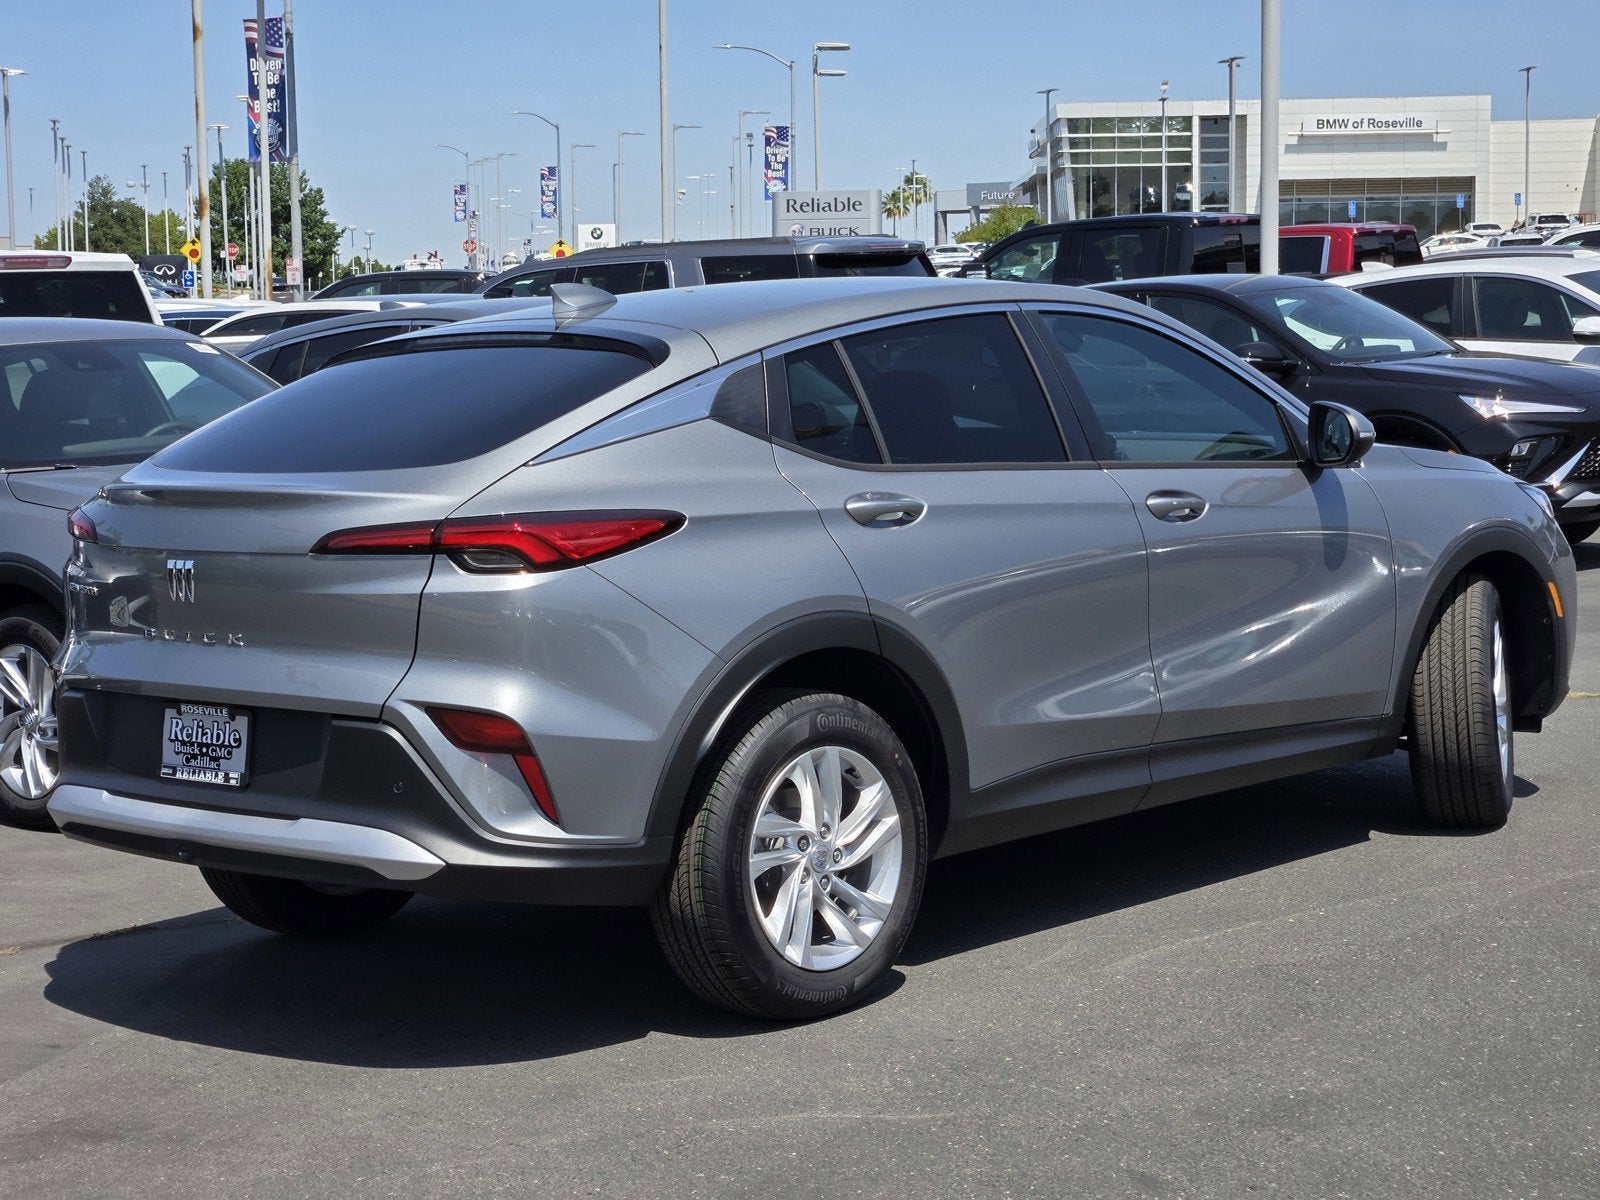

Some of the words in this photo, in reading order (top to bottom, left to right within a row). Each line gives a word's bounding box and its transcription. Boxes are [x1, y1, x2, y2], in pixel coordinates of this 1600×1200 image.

[267, 71, 280, 85] Be
[254, 100, 280, 113] Bst!
[1316, 118, 1349, 129] BMW
[1352, 117, 1364, 129] of
[1367, 117, 1423, 129] Roseville
[981, 190, 1015, 201] Future
[786, 197, 863, 213] Reliable
[810, 226, 860, 236] BUICK
[584, 241, 602, 249] BMW
[181, 704, 229, 717] ROSEVILLE
[170, 717, 241, 747] Reliable
[174, 741, 201, 754] Buick
[208, 746, 233, 759] GMC
[182, 754, 221, 769] Cadillac
[176, 767, 225, 783] RELIABLE
